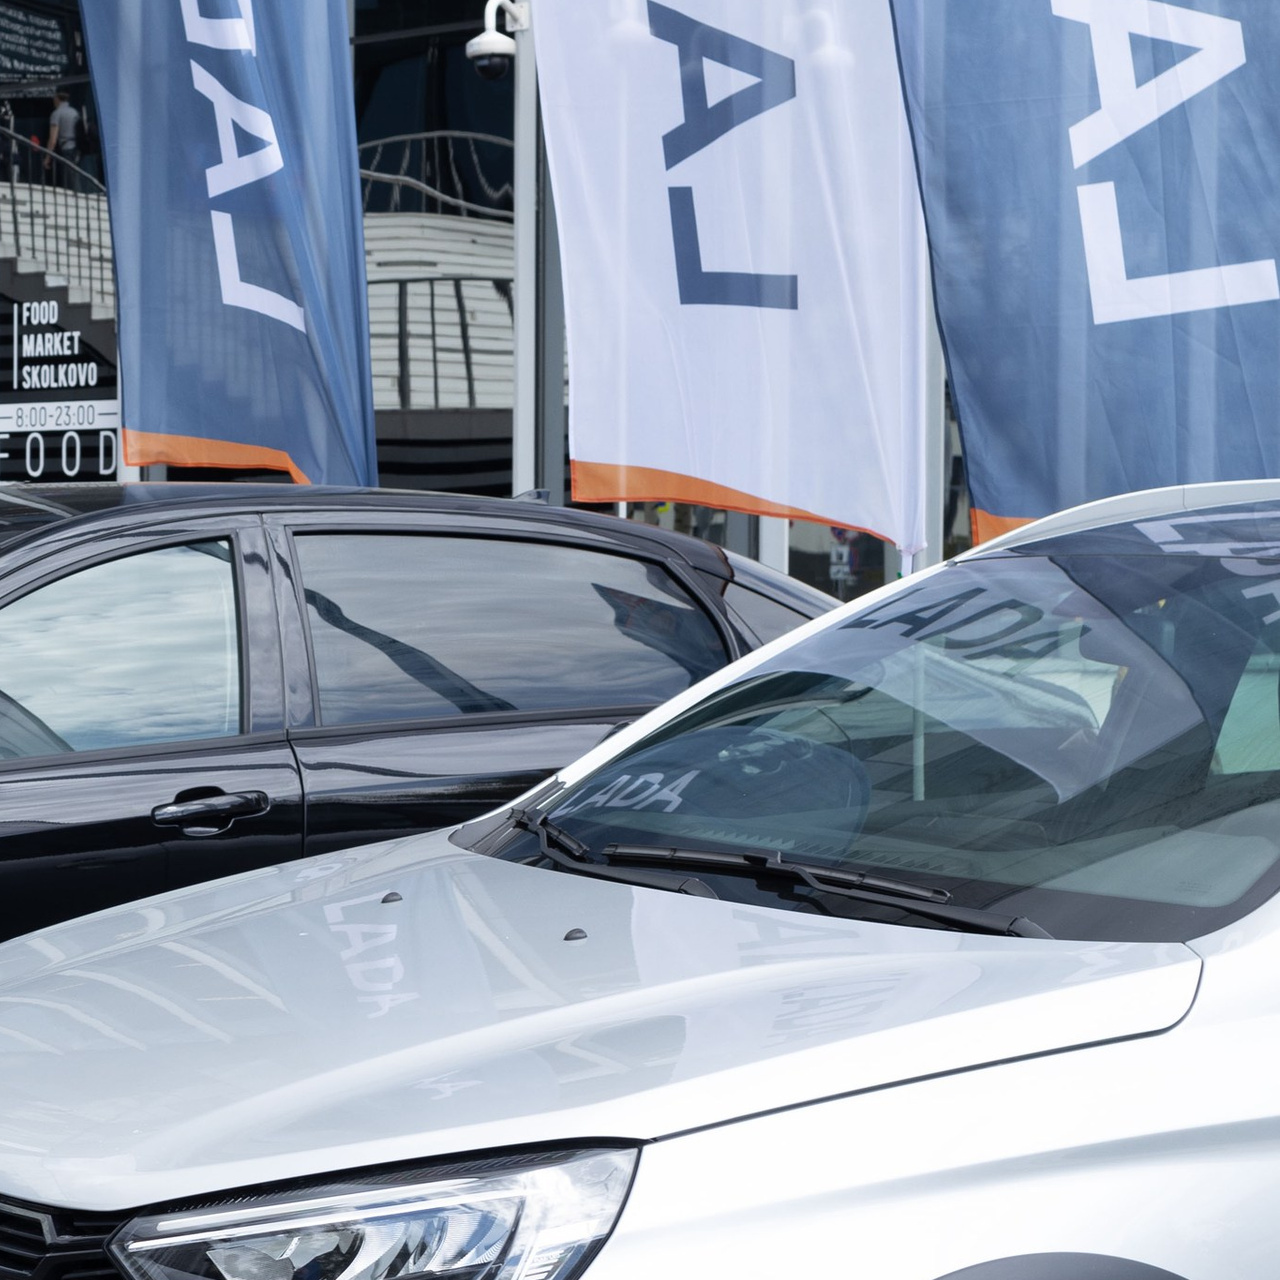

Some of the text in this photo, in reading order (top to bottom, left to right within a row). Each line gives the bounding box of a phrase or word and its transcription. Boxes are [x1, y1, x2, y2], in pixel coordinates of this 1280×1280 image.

[22, 300, 59, 326] FOOD
[22, 331, 81, 358] MARKET
[22, 362, 98, 390] SKOLKOVO
[16, 404, 96, 428] 8:00-23:00
